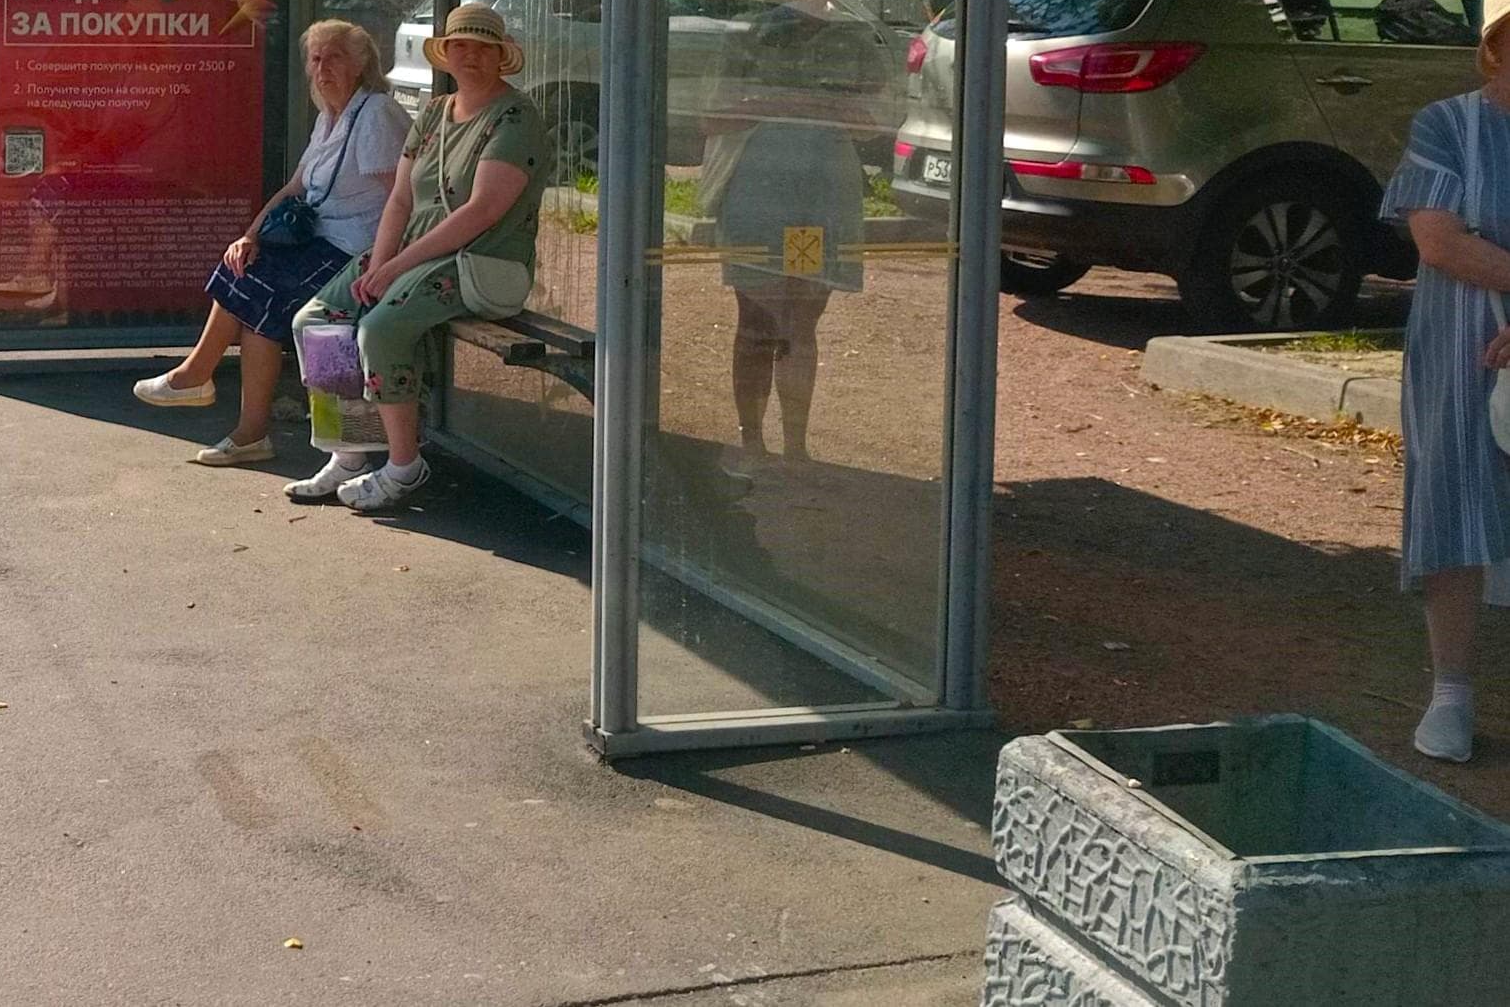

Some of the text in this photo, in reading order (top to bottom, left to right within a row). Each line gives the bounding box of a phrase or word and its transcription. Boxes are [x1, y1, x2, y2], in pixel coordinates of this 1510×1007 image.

[11, 12, 210, 36] ЗА ПОКУПКИ
[27, 59, 89, 73] Совершите
[90, 62, 133, 73] покупку
[135, 63, 148, 71] на
[149, 63, 183, 73] сумму
[184, 63, 196, 71] от
[198, 60, 226, 71] 2500
[27, 83, 80, 97] Получите
[82, 86, 114, 97] купон
[116, 86, 128, 95] на
[129, 86, 167, 97] скидку
[169, 83, 191, 95] 10%
[42, 99, 106, 109] следующую
[108, 99, 151, 110] покупку
